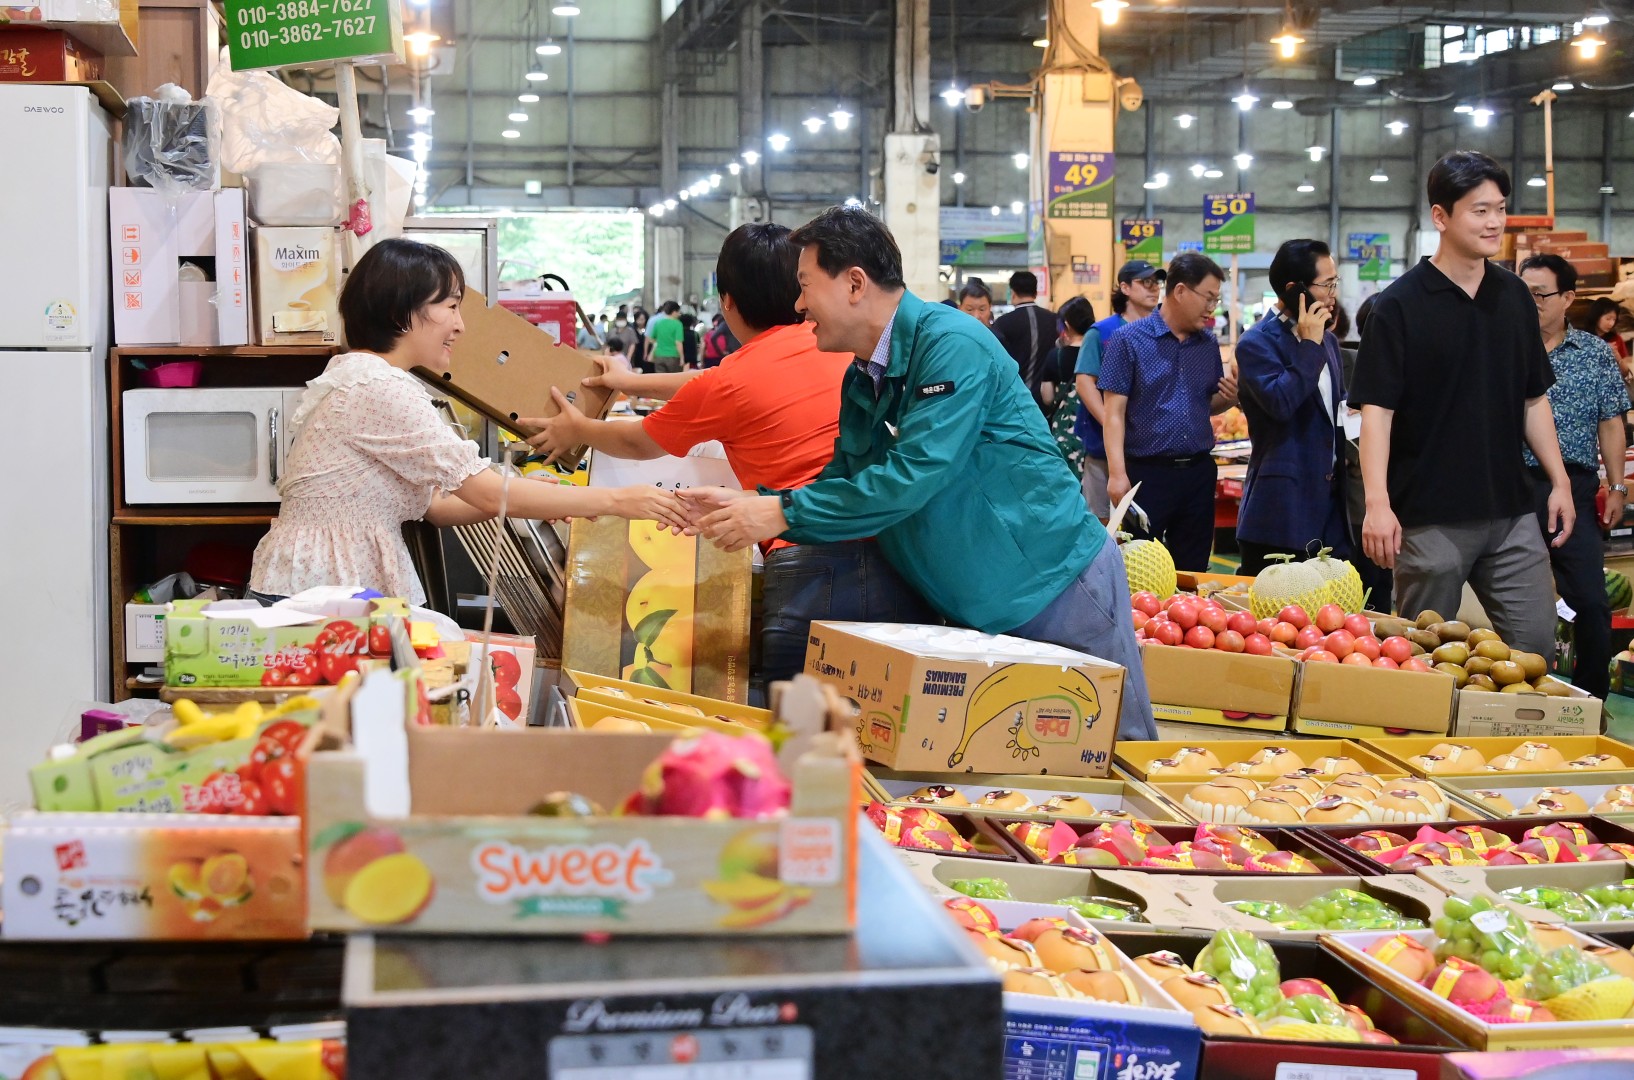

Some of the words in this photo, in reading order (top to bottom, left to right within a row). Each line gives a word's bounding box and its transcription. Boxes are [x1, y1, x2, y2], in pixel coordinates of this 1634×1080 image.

[240, 15, 376, 50] 010-3862-7627
[24, 106, 64, 114] DAEWOO
[1064, 164, 1098, 186] 49
[1210, 198, 1247, 215] 50
[1129, 224, 1155, 237] 49
[274, 244, 321, 260] Maxim
[925, 670, 967, 684] BANANAS
[922, 682, 965, 697] PREMIUM
[870, 724, 892, 744] Dole
[1034, 718, 1070, 738] Dole
[478, 845, 654, 894] Sweet
[564, 997, 705, 1033] Premium
